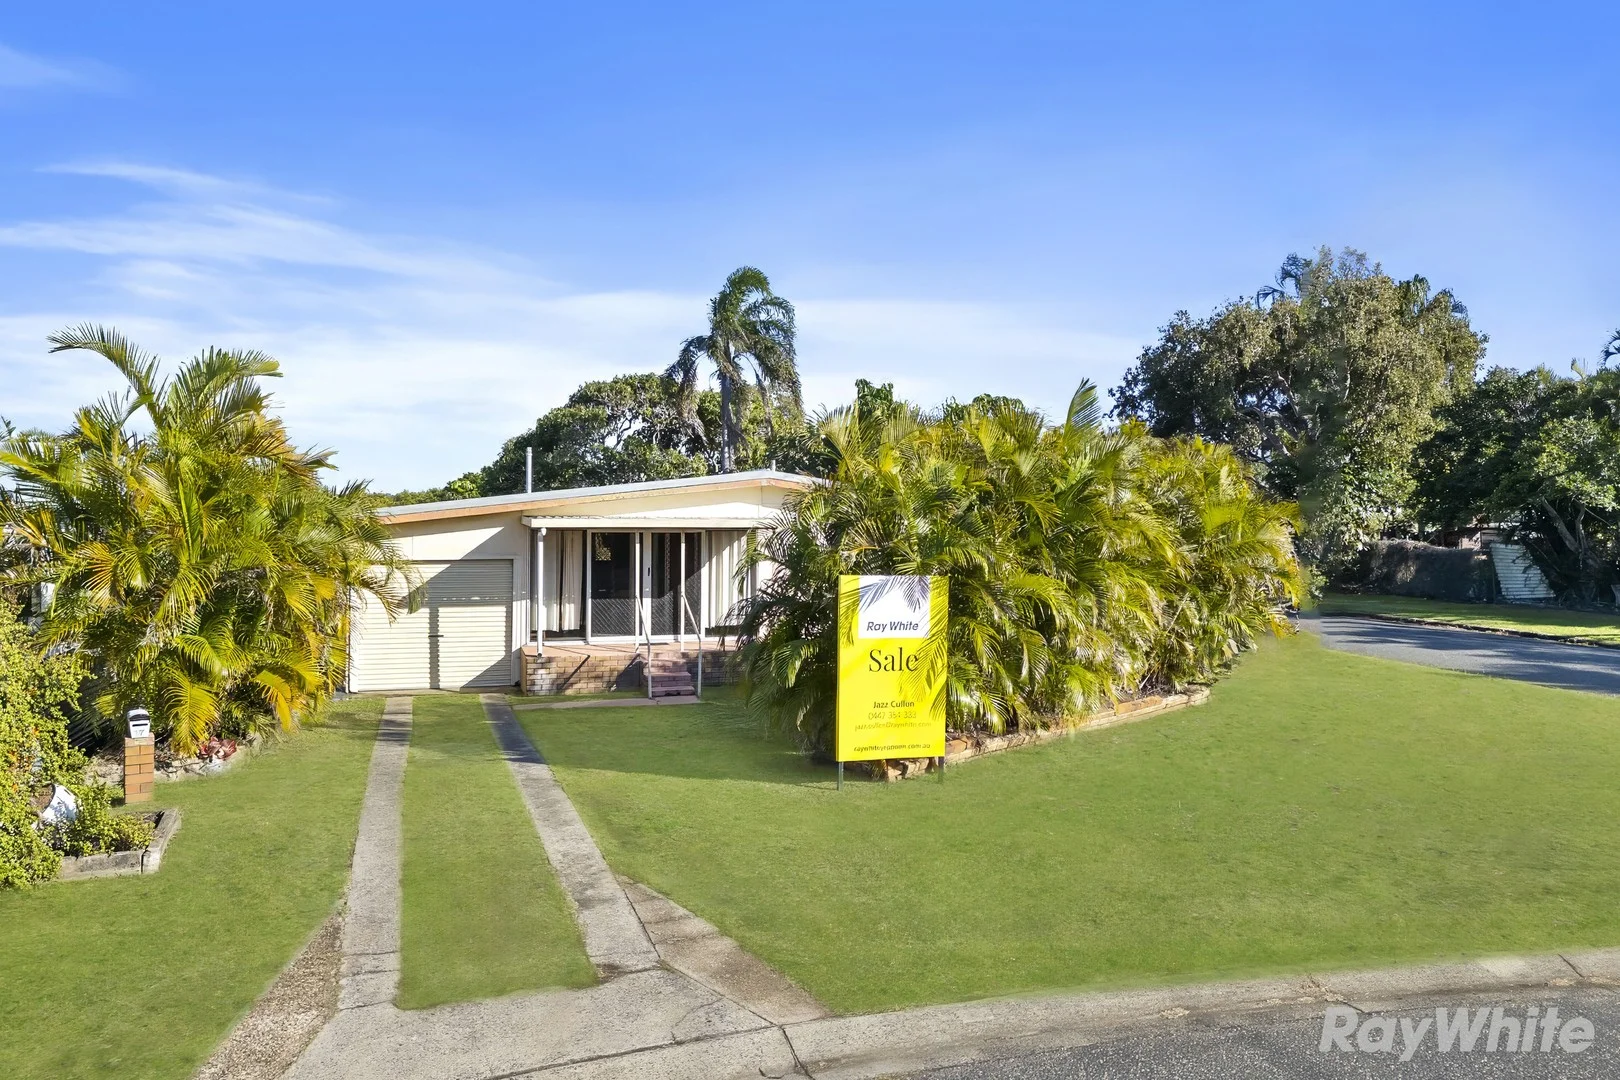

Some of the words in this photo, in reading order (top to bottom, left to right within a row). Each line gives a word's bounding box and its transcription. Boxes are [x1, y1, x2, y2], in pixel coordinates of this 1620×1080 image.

[866, 621, 887, 632] Ray
[889, 620, 919, 631] White
[869, 647, 919, 672] Sale
[873, 701, 888, 709] Jazz
